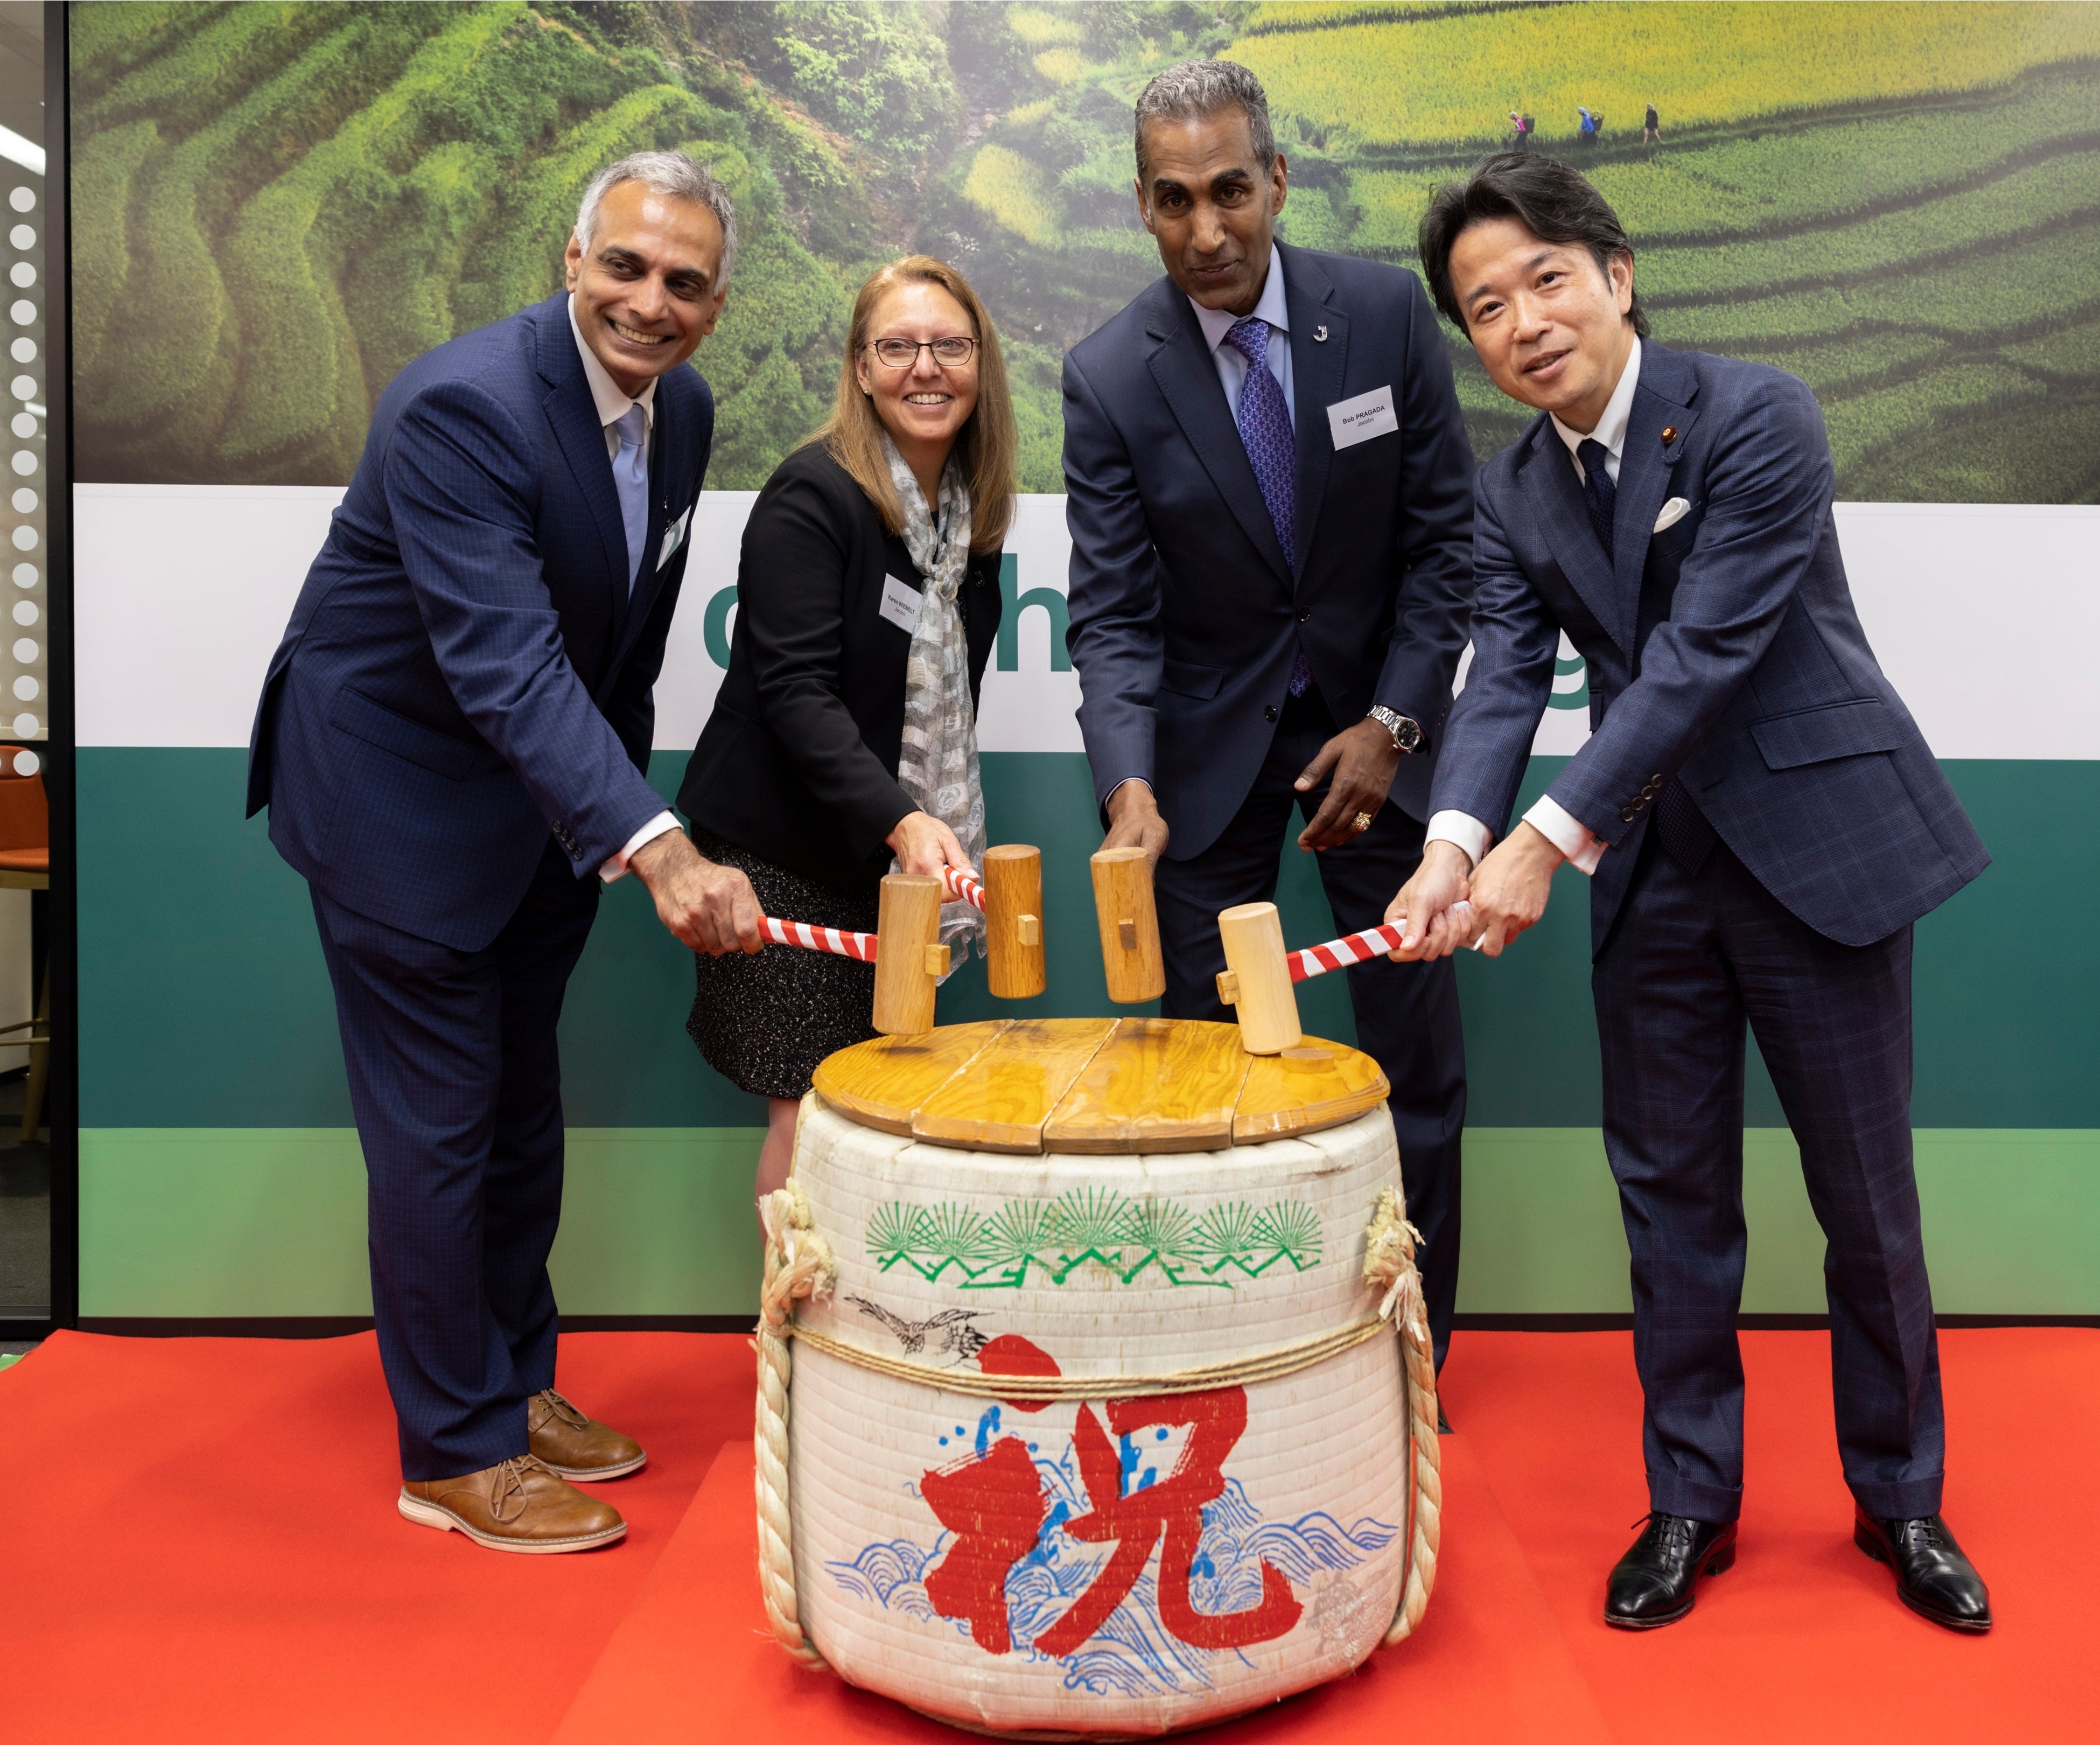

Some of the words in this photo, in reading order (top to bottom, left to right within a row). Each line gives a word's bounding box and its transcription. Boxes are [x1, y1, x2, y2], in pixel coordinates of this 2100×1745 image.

[1313, 325, 1327, 342] J
[1342, 416, 1355, 424] Bob
[1355, 405, 1385, 420] PRAGADA
[1357, 417, 1374, 427] Jacobs
[887, 594, 899, 605] Karen
[899, 600, 915, 615] WIEMELT
[919, 1334, 1304, 1655] 祝
